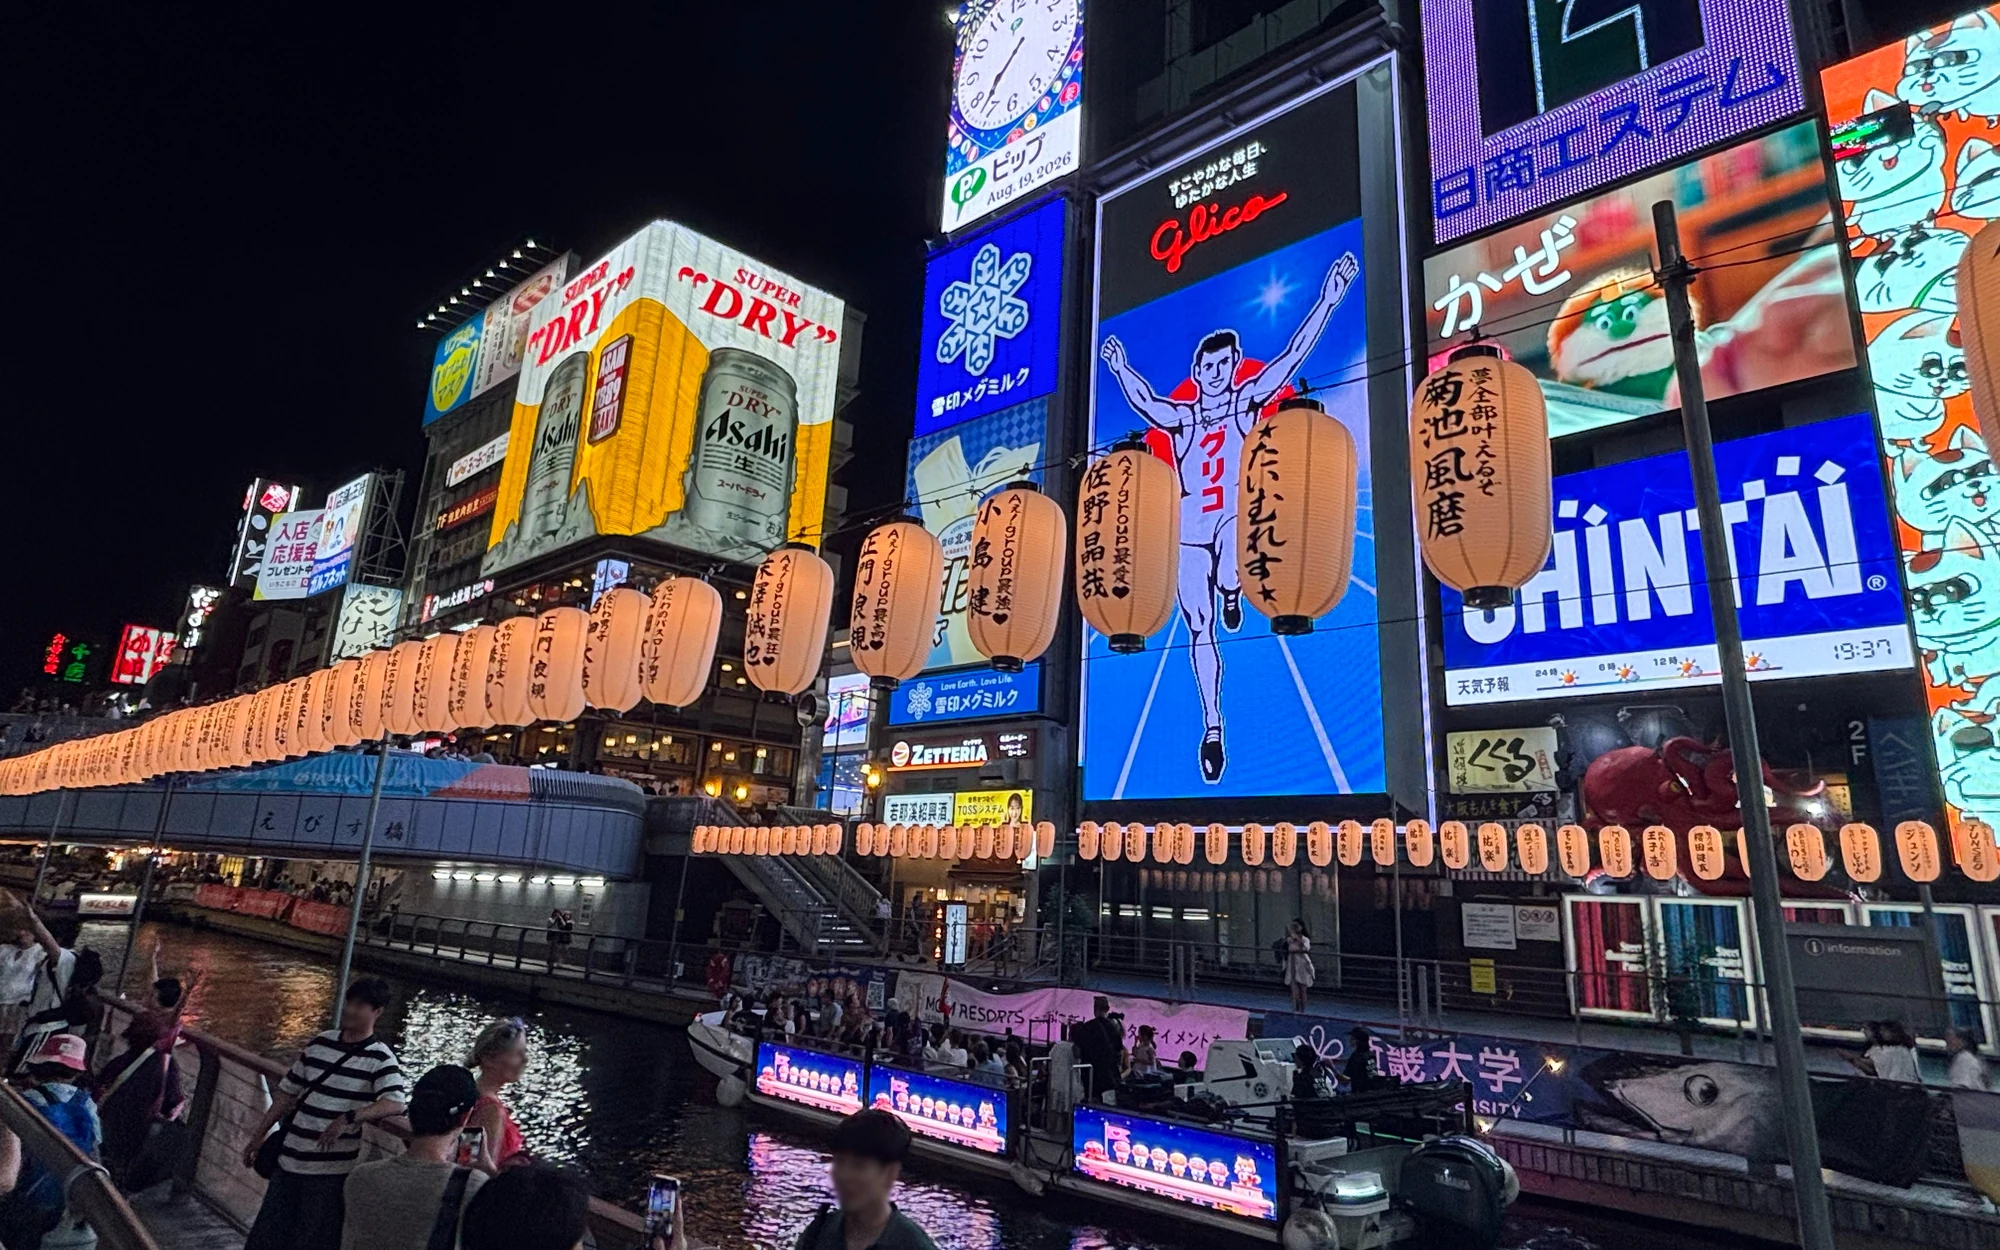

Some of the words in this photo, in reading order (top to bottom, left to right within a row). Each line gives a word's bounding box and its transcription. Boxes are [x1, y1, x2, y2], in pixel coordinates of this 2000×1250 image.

[993, 132, 1046, 182] ピップ
[1435, 56, 1786, 220] 日商エステム
[987, 184, 1016, 206] Aug.
[1036, 151, 1072, 180] 2026
[1175, 162, 1258, 208] ゆたかな人生
[561, 260, 610, 307] SUPER
[733, 267, 802, 309] SUPER
[1435, 214, 1577, 338] かぜ
[738, 384, 769, 401] SUPER
[931, 367, 1030, 418] 雪印メグミルク
[533, 409, 578, 463] Asahi
[705, 408, 787, 464] Asahi
[1469, 367, 1502, 497] 夢全部叶えるぞ
[734, 454, 755, 475] 生
[1199, 424, 1228, 514] グリコ
[1419, 370, 1475, 542] 菊池風磨
[717, 479, 767, 501] スーパードライ
[270, 542, 318, 564] 応援金
[276, 520, 310, 542] 入店
[1080, 460, 1112, 601] 佐野晶哉
[267, 565, 315, 577] プレゼント中
[968, 498, 1002, 620] 小島健
[850, 531, 882, 652] 正門良規
[596, 593, 617, 642] なにわ男子
[531, 615, 557, 700] 正門良規
[1833, 639, 1892, 661] 19:37
[935, 689, 1018, 714] 雪印メグミルク
[941, 682, 955, 691] Love
[957, 679, 979, 688] Earth.
[981, 677, 997, 686] Love
[1457, 677, 1510, 695] 天気予報
[910, 744, 988, 765] ZETTERIA
[1453, 739, 1468, 787] 道頓堀
[1467, 737, 1537, 783] くくる
[259, 811, 405, 841] えびす橋
[958, 805, 1004, 816] TOSSシステム
[1905, 829, 1921, 872] ジュンソ
[1827, 942, 1901, 957] information
[959, 1004, 1025, 1024] RESORTS
